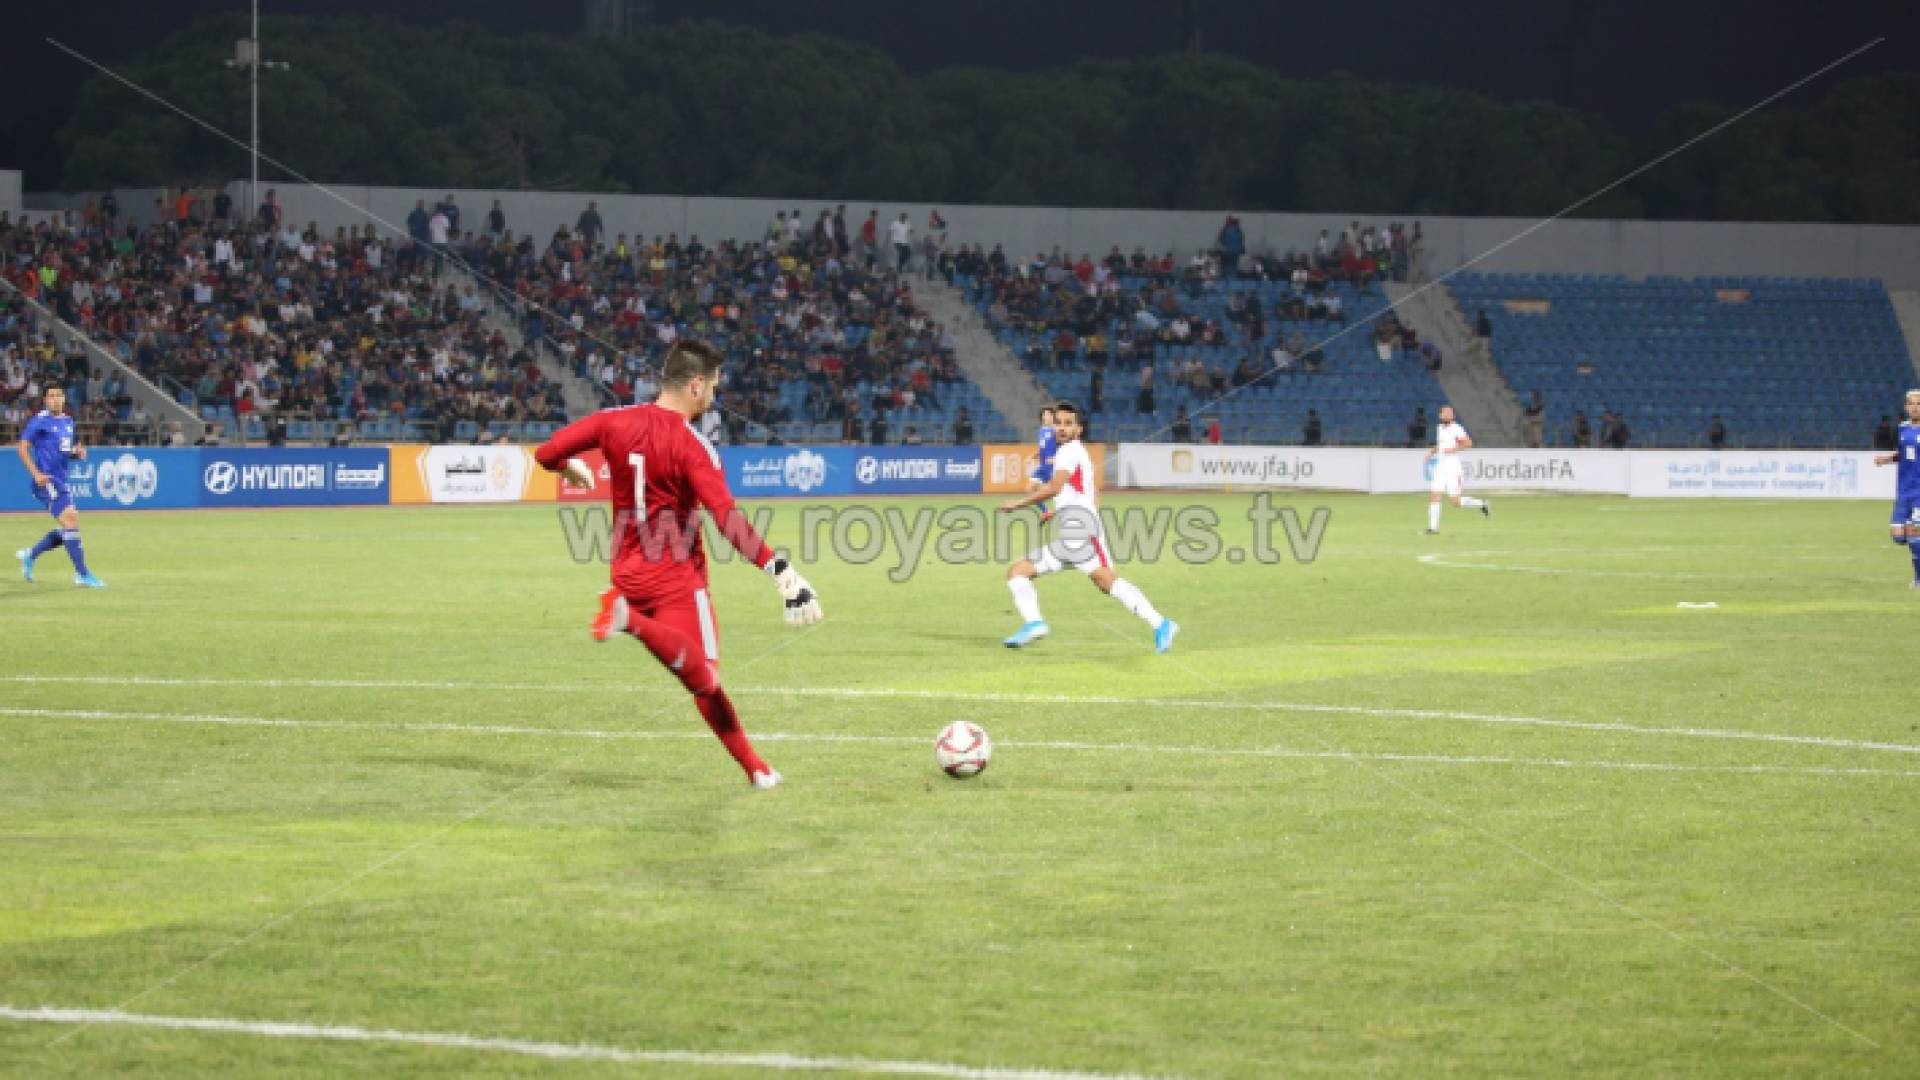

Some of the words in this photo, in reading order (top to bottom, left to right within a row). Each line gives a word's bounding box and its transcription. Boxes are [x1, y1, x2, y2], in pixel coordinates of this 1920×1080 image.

[242, 463, 325, 489] HYUNDAI
[882, 458, 938, 479] HYUNDAI
[1201, 455, 1314, 480] www.jfa.jo
[627, 453, 646, 522] 1
